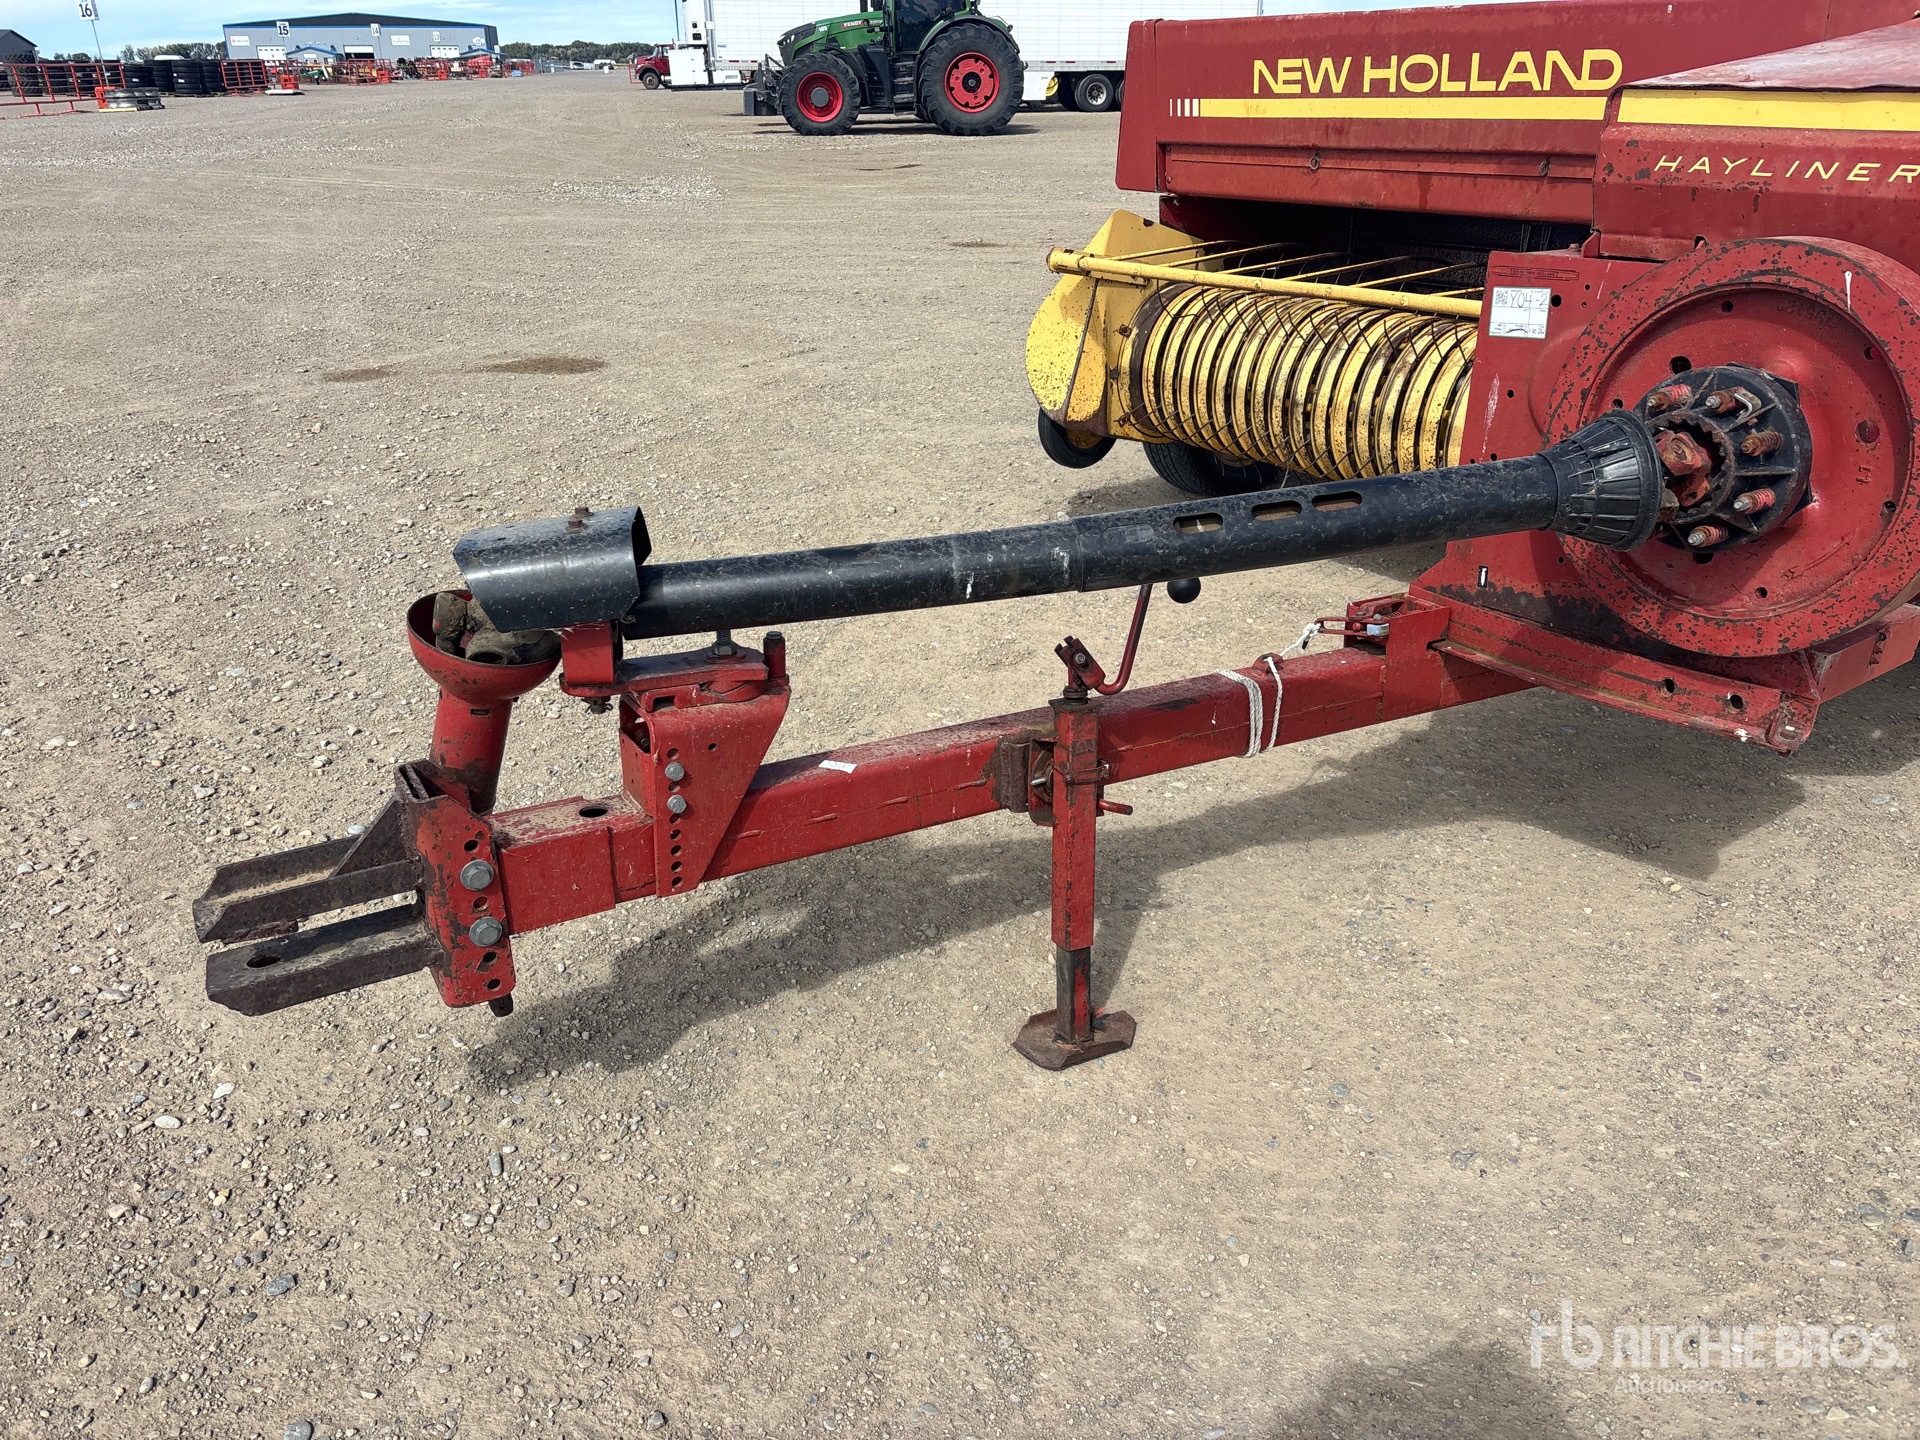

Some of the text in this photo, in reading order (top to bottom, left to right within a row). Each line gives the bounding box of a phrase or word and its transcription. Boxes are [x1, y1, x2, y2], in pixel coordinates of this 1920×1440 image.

[78, 3, 92, 17] 16
[278, 25, 289, 35] 15
[1252, 48, 1623, 94] NEW HOLLAND
[1653, 155, 1920, 184] HAYLINER
